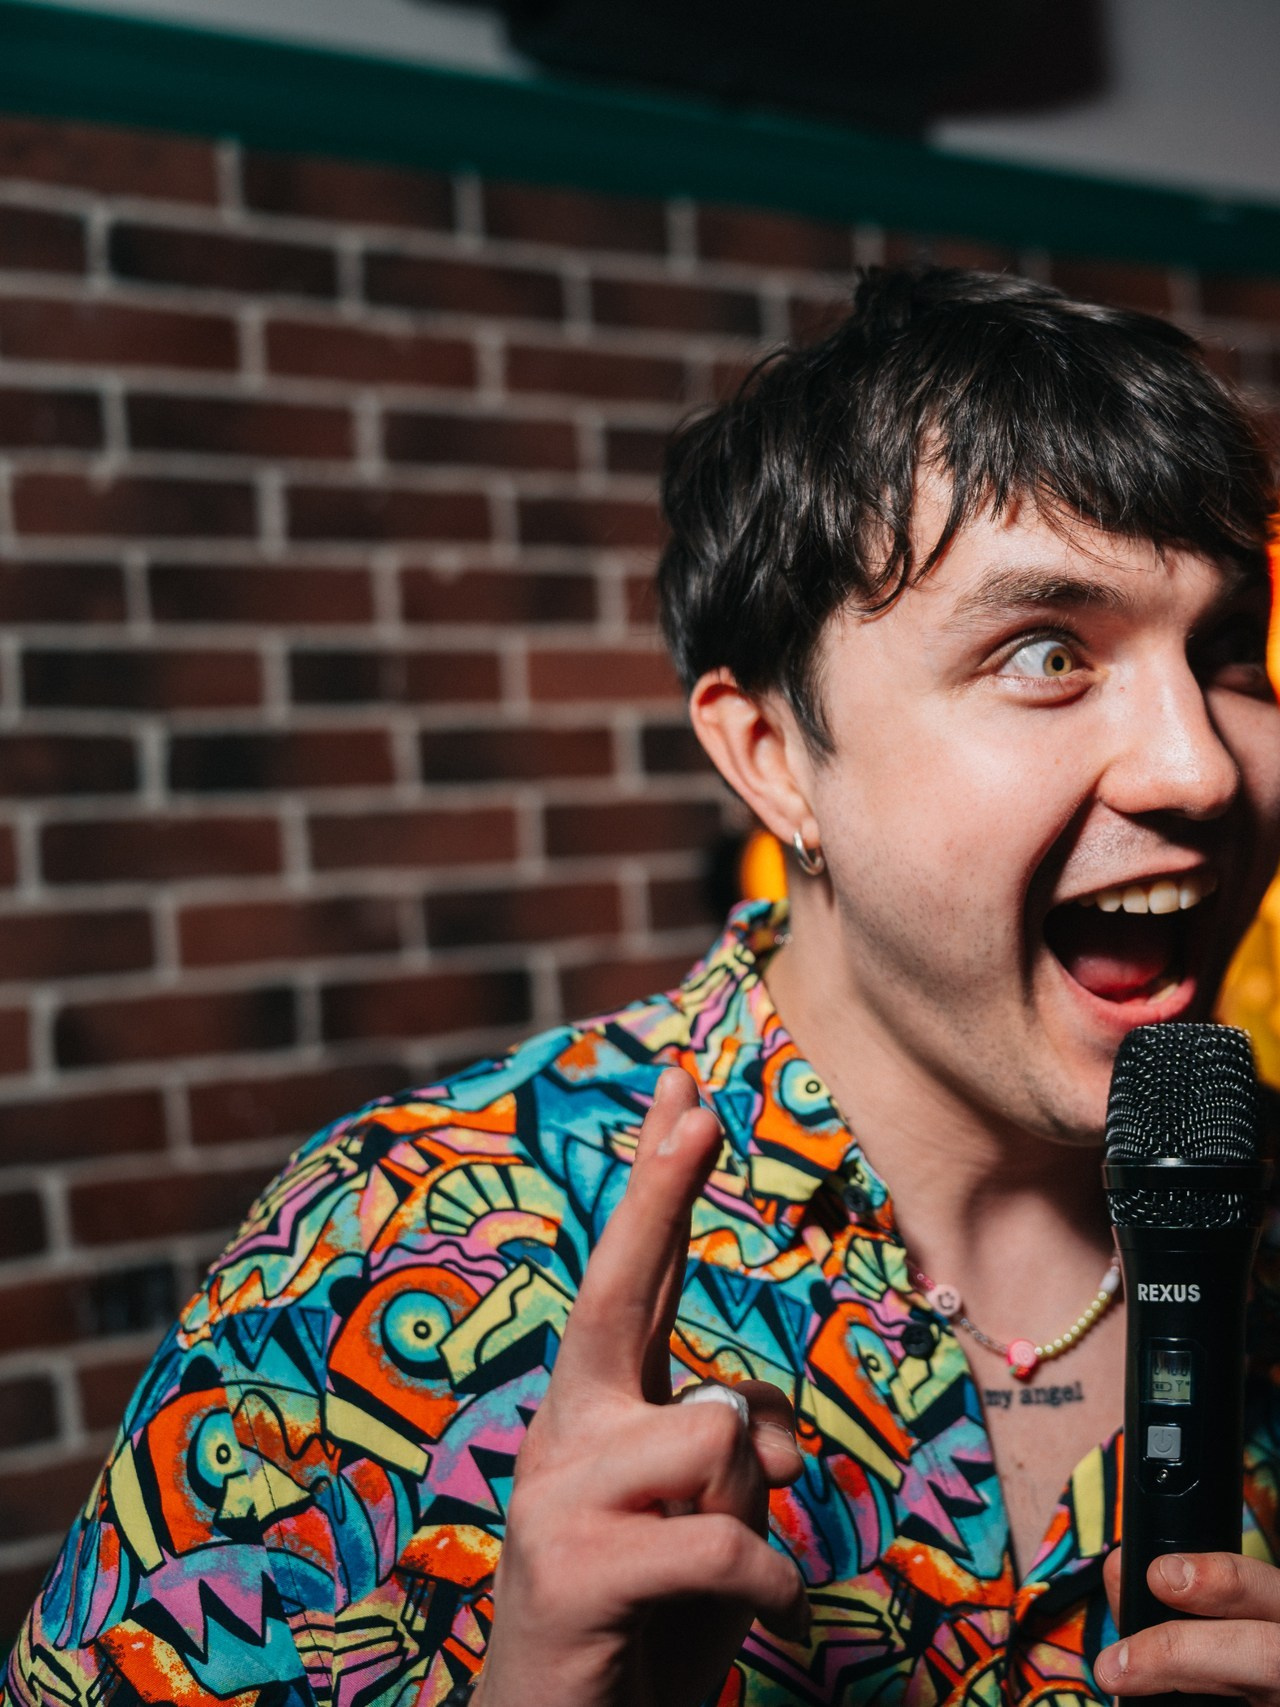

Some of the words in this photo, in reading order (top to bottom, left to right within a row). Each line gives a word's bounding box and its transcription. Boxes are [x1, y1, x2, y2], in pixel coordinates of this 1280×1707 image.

[1137, 1283, 1201, 1302] REXUS
[985, 1389, 1012, 1408] my
[1020, 1380, 1084, 1407] angel
